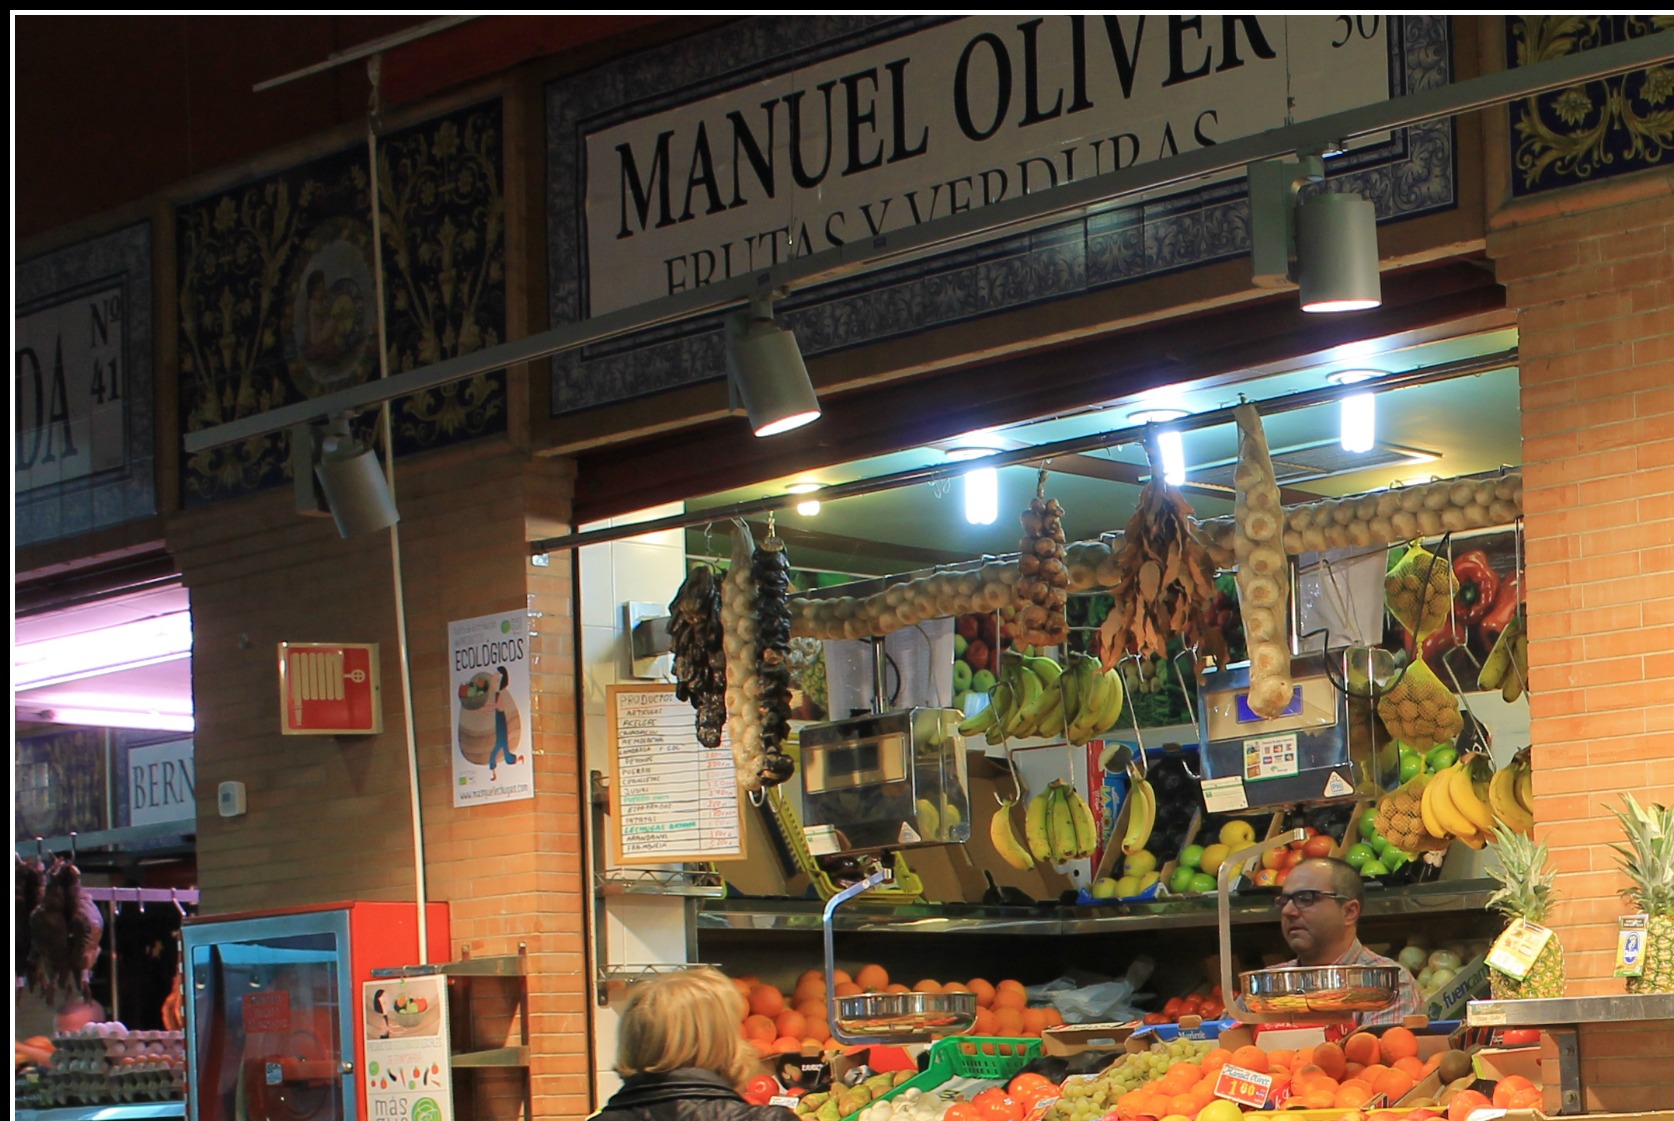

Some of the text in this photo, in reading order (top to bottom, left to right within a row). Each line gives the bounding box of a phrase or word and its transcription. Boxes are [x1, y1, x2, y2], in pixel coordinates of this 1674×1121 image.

[615, 15, 1276, 241] MANUEL OLIVER
[664, 211, 847, 295] FRUTAS
[860, 198, 893, 239] Y
[91, 356, 120, 405] 41
[455, 638, 524, 671] ECOLÓGICOS
[620, 693, 674, 707] PRODUCTOS
[375, 1095, 408, 1116] más
